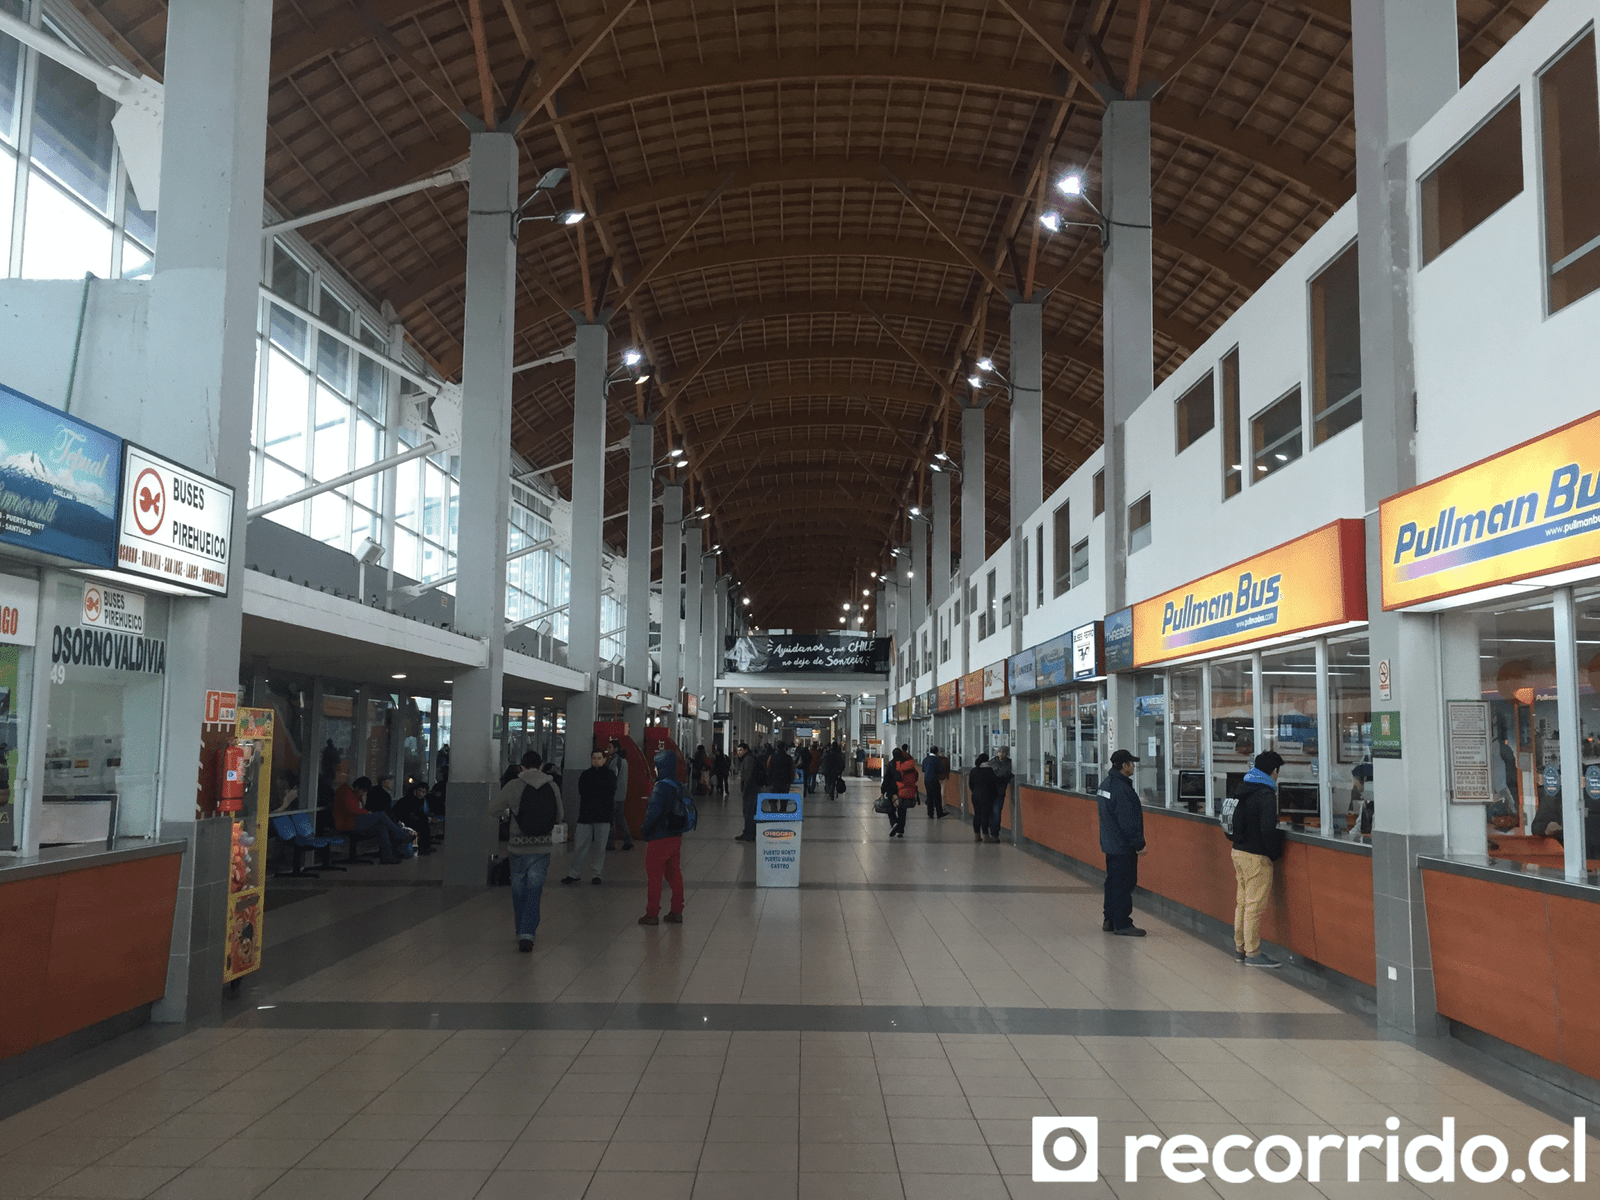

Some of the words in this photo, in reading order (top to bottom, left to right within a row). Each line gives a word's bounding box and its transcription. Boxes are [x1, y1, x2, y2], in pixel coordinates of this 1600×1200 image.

[172, 477, 205, 511] BUSES
[5, 514, 27, 526] PUERTO
[5, 523, 32, 536] SANTIAGO
[1393, 492, 1539, 564] Pullman
[172, 520, 227, 560] PIREHUEICO
[104, 591, 126, 610] BUSES
[1162, 591, 1233, 635] Pullman
[1235, 572, 1282, 614] Bus
[104, 609, 143, 631] PIREHUEICO
[832, 646, 845, 656] que
[848, 641, 875, 653] CHILE
[793, 657, 810, 668] deje
[812, 657, 824, 666] de
[50, 664, 67, 685] 49
